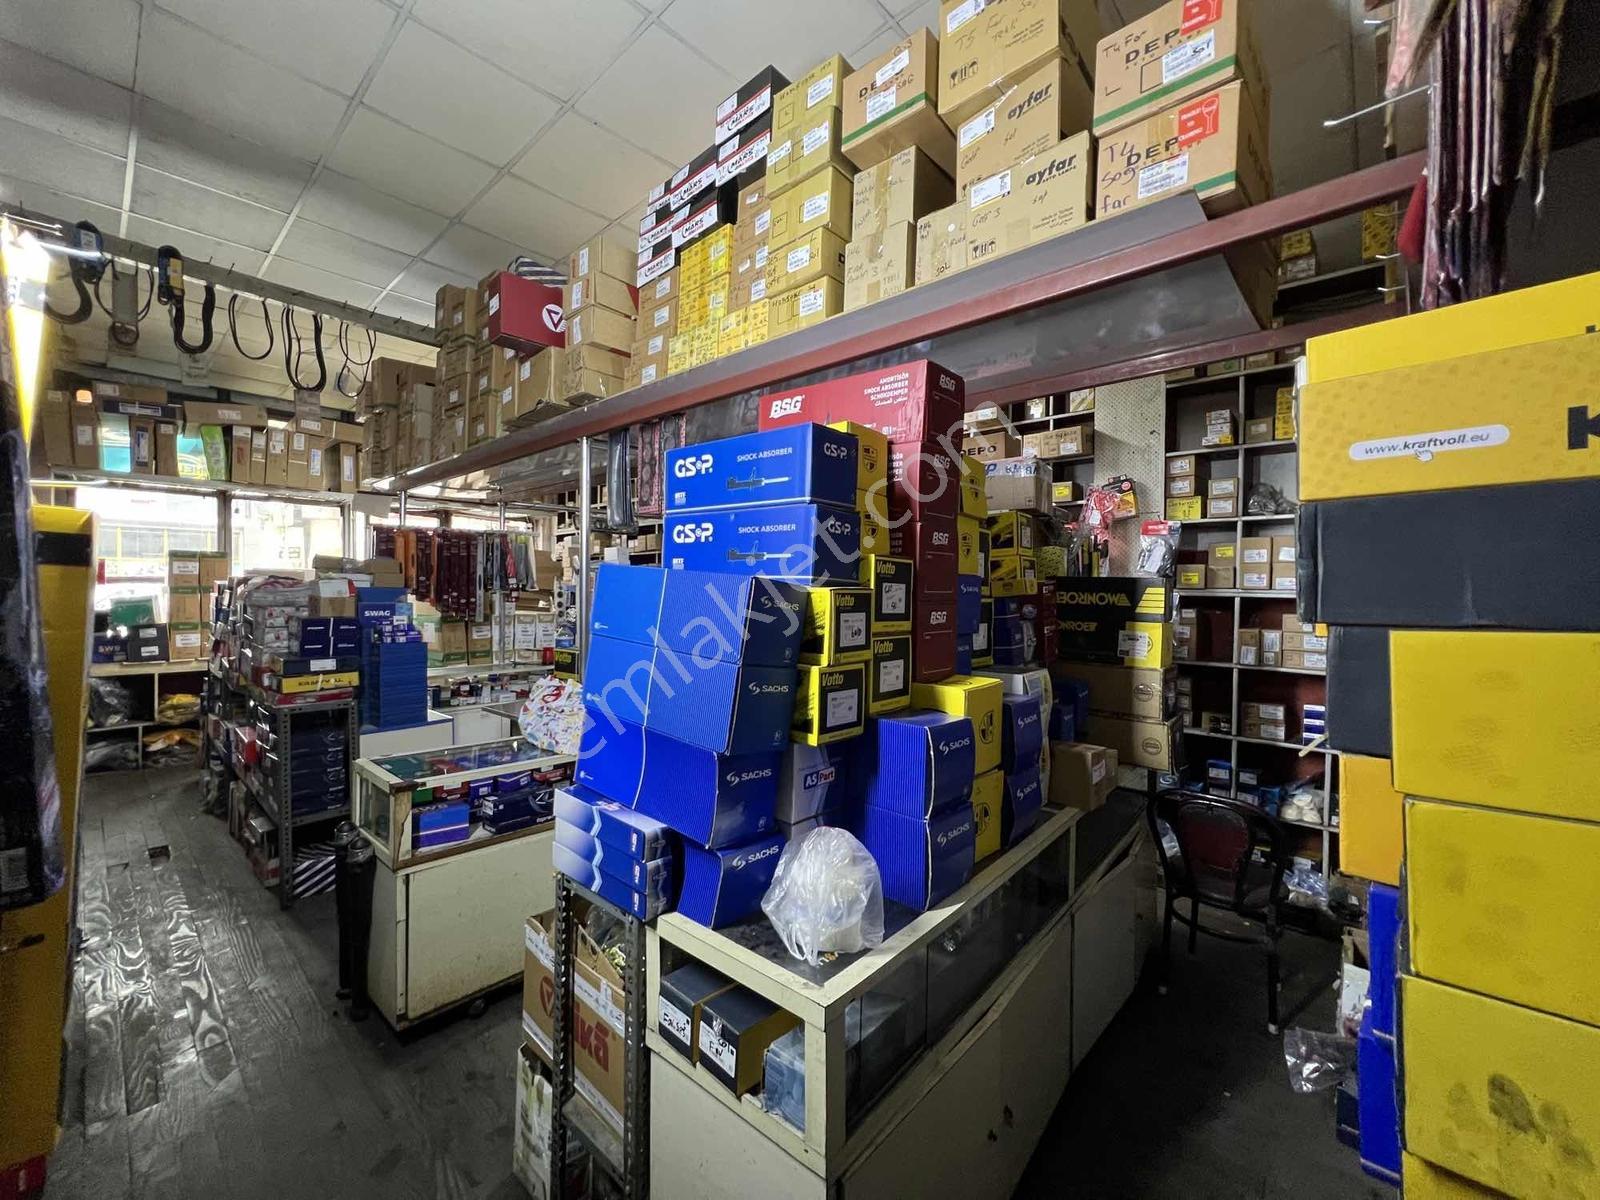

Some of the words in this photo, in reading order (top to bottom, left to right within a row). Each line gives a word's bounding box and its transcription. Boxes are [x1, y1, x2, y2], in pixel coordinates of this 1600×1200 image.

[1125, 28, 1180, 64] DEP
[1007, 82, 1053, 119] ayfar
[1126, 135, 1179, 167] DEP
[1025, 154, 1077, 185] ayfar
[939, 373, 956, 392] BSG
[769, 396, 804, 419] BSG
[1364, 430, 1491, 456] www.kraftvoll.eu
[736, 453, 757, 463] SHOCK
[758, 447, 792, 459] ABSORBER
[738, 526, 759, 534] SHOCK
[760, 523, 796, 532] ABSORBER
[932, 532, 949, 545] BSG
[876, 561, 895, 574] Votto
[773, 600, 800, 611] SACHS
[836, 594, 855, 607] Votto
[930, 611, 947, 625] BSG
[875, 641, 893, 654] Votto
[822, 673, 844, 686] Votto
[761, 684, 789, 692] SACHS
[949, 737, 971, 751] SACHS
[741, 768, 772, 781] SACHS
[805, 774, 817, 787] AS
[819, 770, 835, 781] Part
[948, 823, 970, 840] SACHS
[747, 845, 779, 863] SACHS
